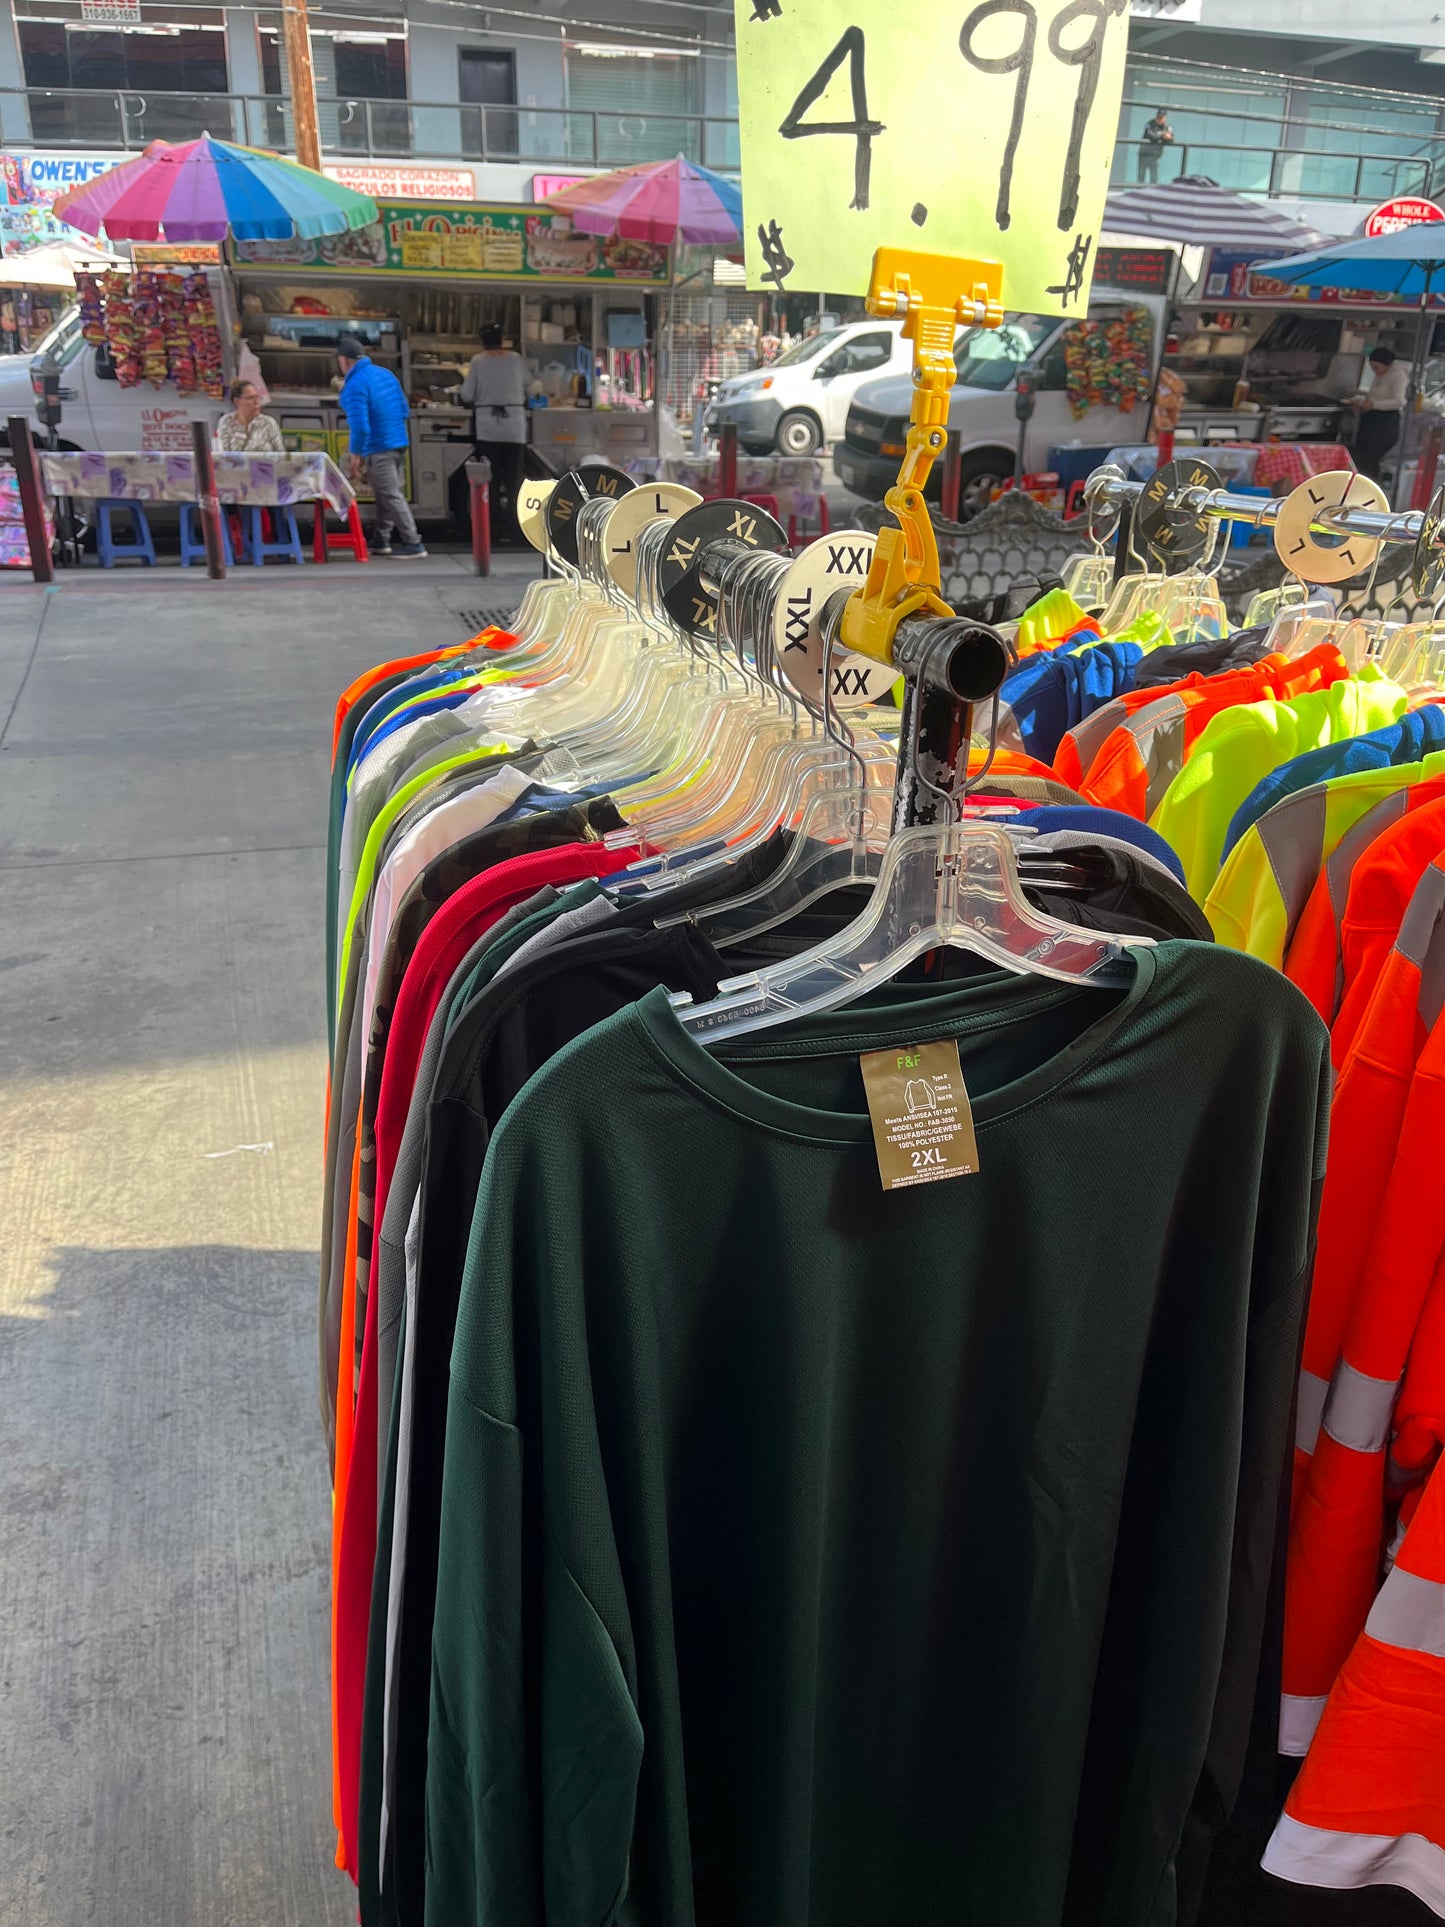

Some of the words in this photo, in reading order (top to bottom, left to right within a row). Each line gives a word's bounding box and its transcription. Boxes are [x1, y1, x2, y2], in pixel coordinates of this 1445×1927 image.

[31, 160, 104, 181] OWEN'S
[336, 168, 396, 180] SAGRADO
[401, 183, 473, 197] RELIGIOSOS
[1392, 204, 1431, 217] WHOLE
[596, 474, 618, 496] M
[1189, 468, 1209, 486] M
[1148, 480, 1168, 502] M
[1308, 489, 1325, 504] L
[526, 497, 541, 511] S
[553, 498, 574, 521] M
[656, 493, 669, 513] L
[726, 510, 758, 546] XL
[1154, 525, 1174, 545] M
[612, 540, 631, 553] L
[666, 536, 701, 571] XL
[1289, 538, 1306, 555] L
[1339, 550, 1356, 565] L
[691, 597, 718, 633] XL
[784, 587, 812, 654] XXL
[897, 1054, 921, 1069] F&F
[884, 1117, 902, 1125] Meets
[932, 1106, 958, 1116] 107-2015
[886, 1123, 963, 1143] TISSU/FABRIC/GEWEBE
[892, 1124, 913, 1133] MODEL
[898, 1141, 915, 1149] 100%
[916, 1133, 954, 1146] POLYESTER
[911, 1147, 948, 1167] 2XL
